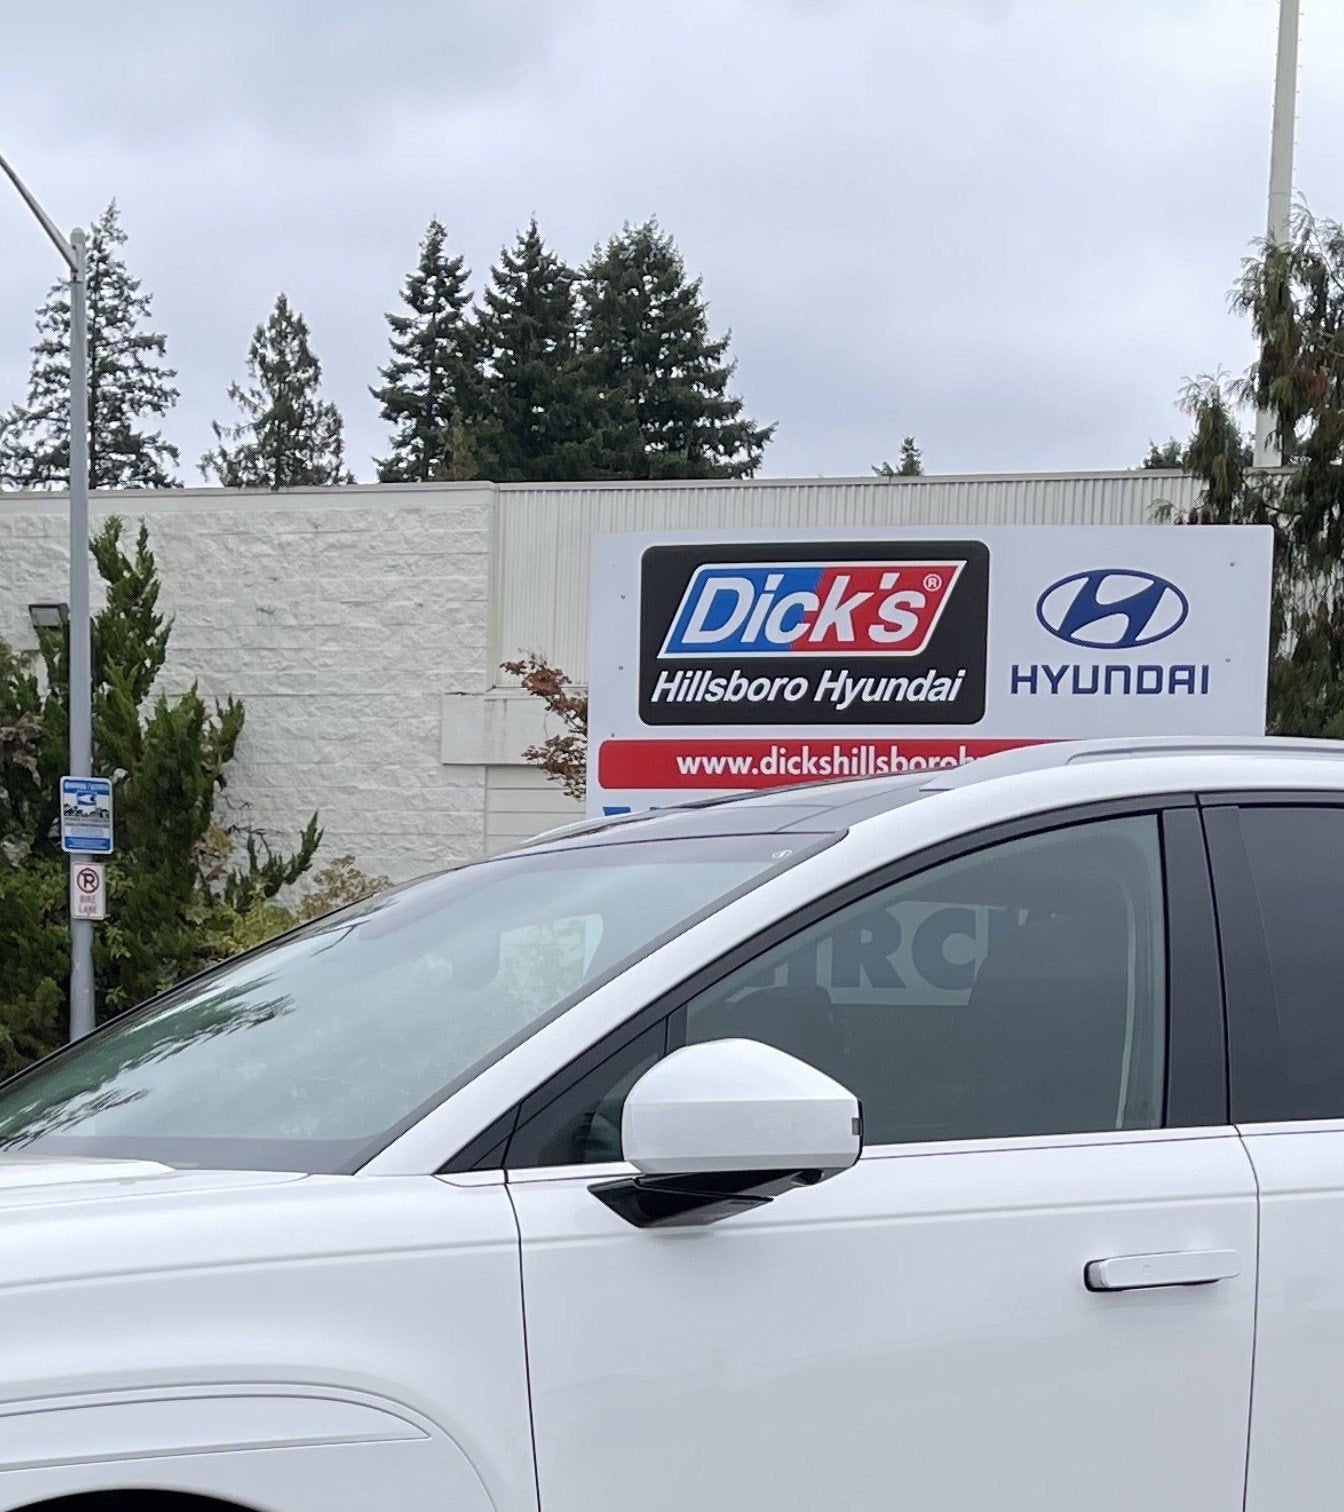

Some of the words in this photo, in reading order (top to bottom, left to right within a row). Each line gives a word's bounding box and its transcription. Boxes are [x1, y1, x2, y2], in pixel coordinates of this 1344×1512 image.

[679, 571, 926, 646] Dick's
[651, 669, 809, 702] Hillsboro
[813, 669, 966, 711] Hyundai
[1011, 665, 1209, 695] HYUNDAI
